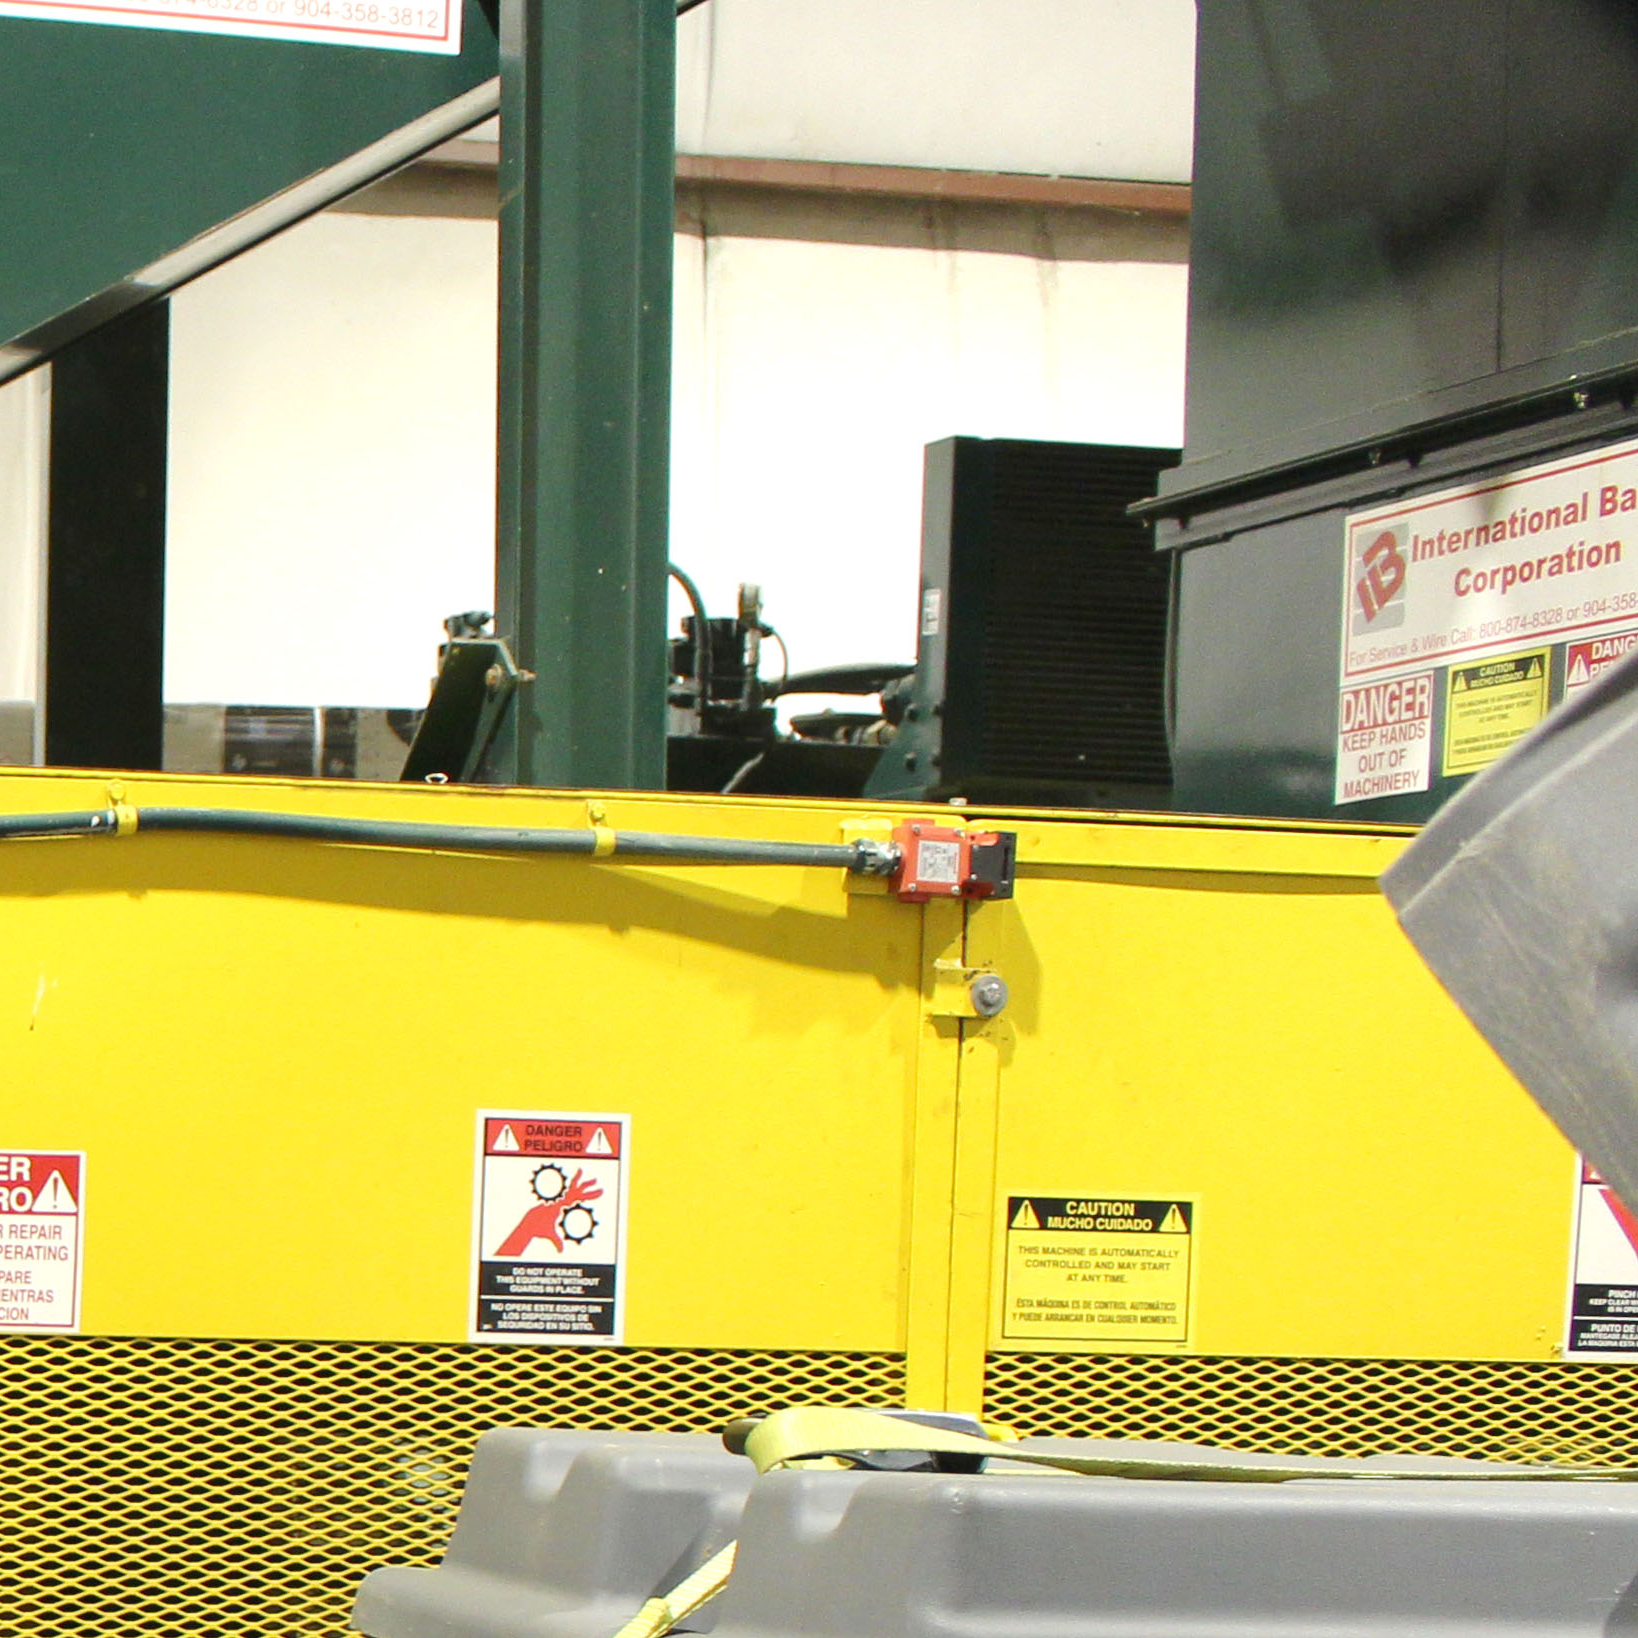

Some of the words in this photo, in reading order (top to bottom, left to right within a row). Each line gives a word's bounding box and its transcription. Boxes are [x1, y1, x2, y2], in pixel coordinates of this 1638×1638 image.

[266, 0, 285, 14] or
[294, 0, 439, 29] 904-358-3812
[1411, 491, 1589, 563] International
[1453, 539, 1622, 597] Corporation
[1349, 650, 1368, 666] For
[1369, 645, 1407, 664] Service
[1411, 639, 1420, 652] &
[1422, 634, 1447, 649] Wire
[1479, 609, 1563, 639] 800-874-8328
[1565, 604, 1581, 619] or
[1592, 636, 1638, 659] DANG
[1479, 661, 1516, 677] CAUTION
[1340, 676, 1429, 733] DANGER
[1342, 731, 1376, 752] KEEP
[1378, 721, 1425, 747] HANDS
[1358, 752, 1385, 774] OUT
[1388, 749, 1407, 767] OF
[1343, 771, 1420, 799] MACHINERY
[525, 1124, 582, 1137] DANGER
[524, 1139, 583, 1153] PELIGRO
[1065, 1201, 1135, 1216] CAUTION
[8, 1224, 63, 1240] REPAIR
[1047, 1216, 1095, 1229] MUCHO
[1095, 1217, 1153, 1231] CUIDADO
[1018, 1245, 1040, 1255] THIS
[1042, 1246, 1086, 1257] MACHINE
[1089, 1247, 1099, 1257] IS
[1100, 1247, 1180, 1259] AUTOMATICALLY
[1025, 1259, 1091, 1269] CONTROLLED
[1093, 1260, 1115, 1270] AND
[1117, 1261, 1137, 1271] MAY
[1140, 1262, 1171, 1271] START
[1066, 1273, 1079, 1282] AT
[1081, 1274, 1101, 1282] ANY
